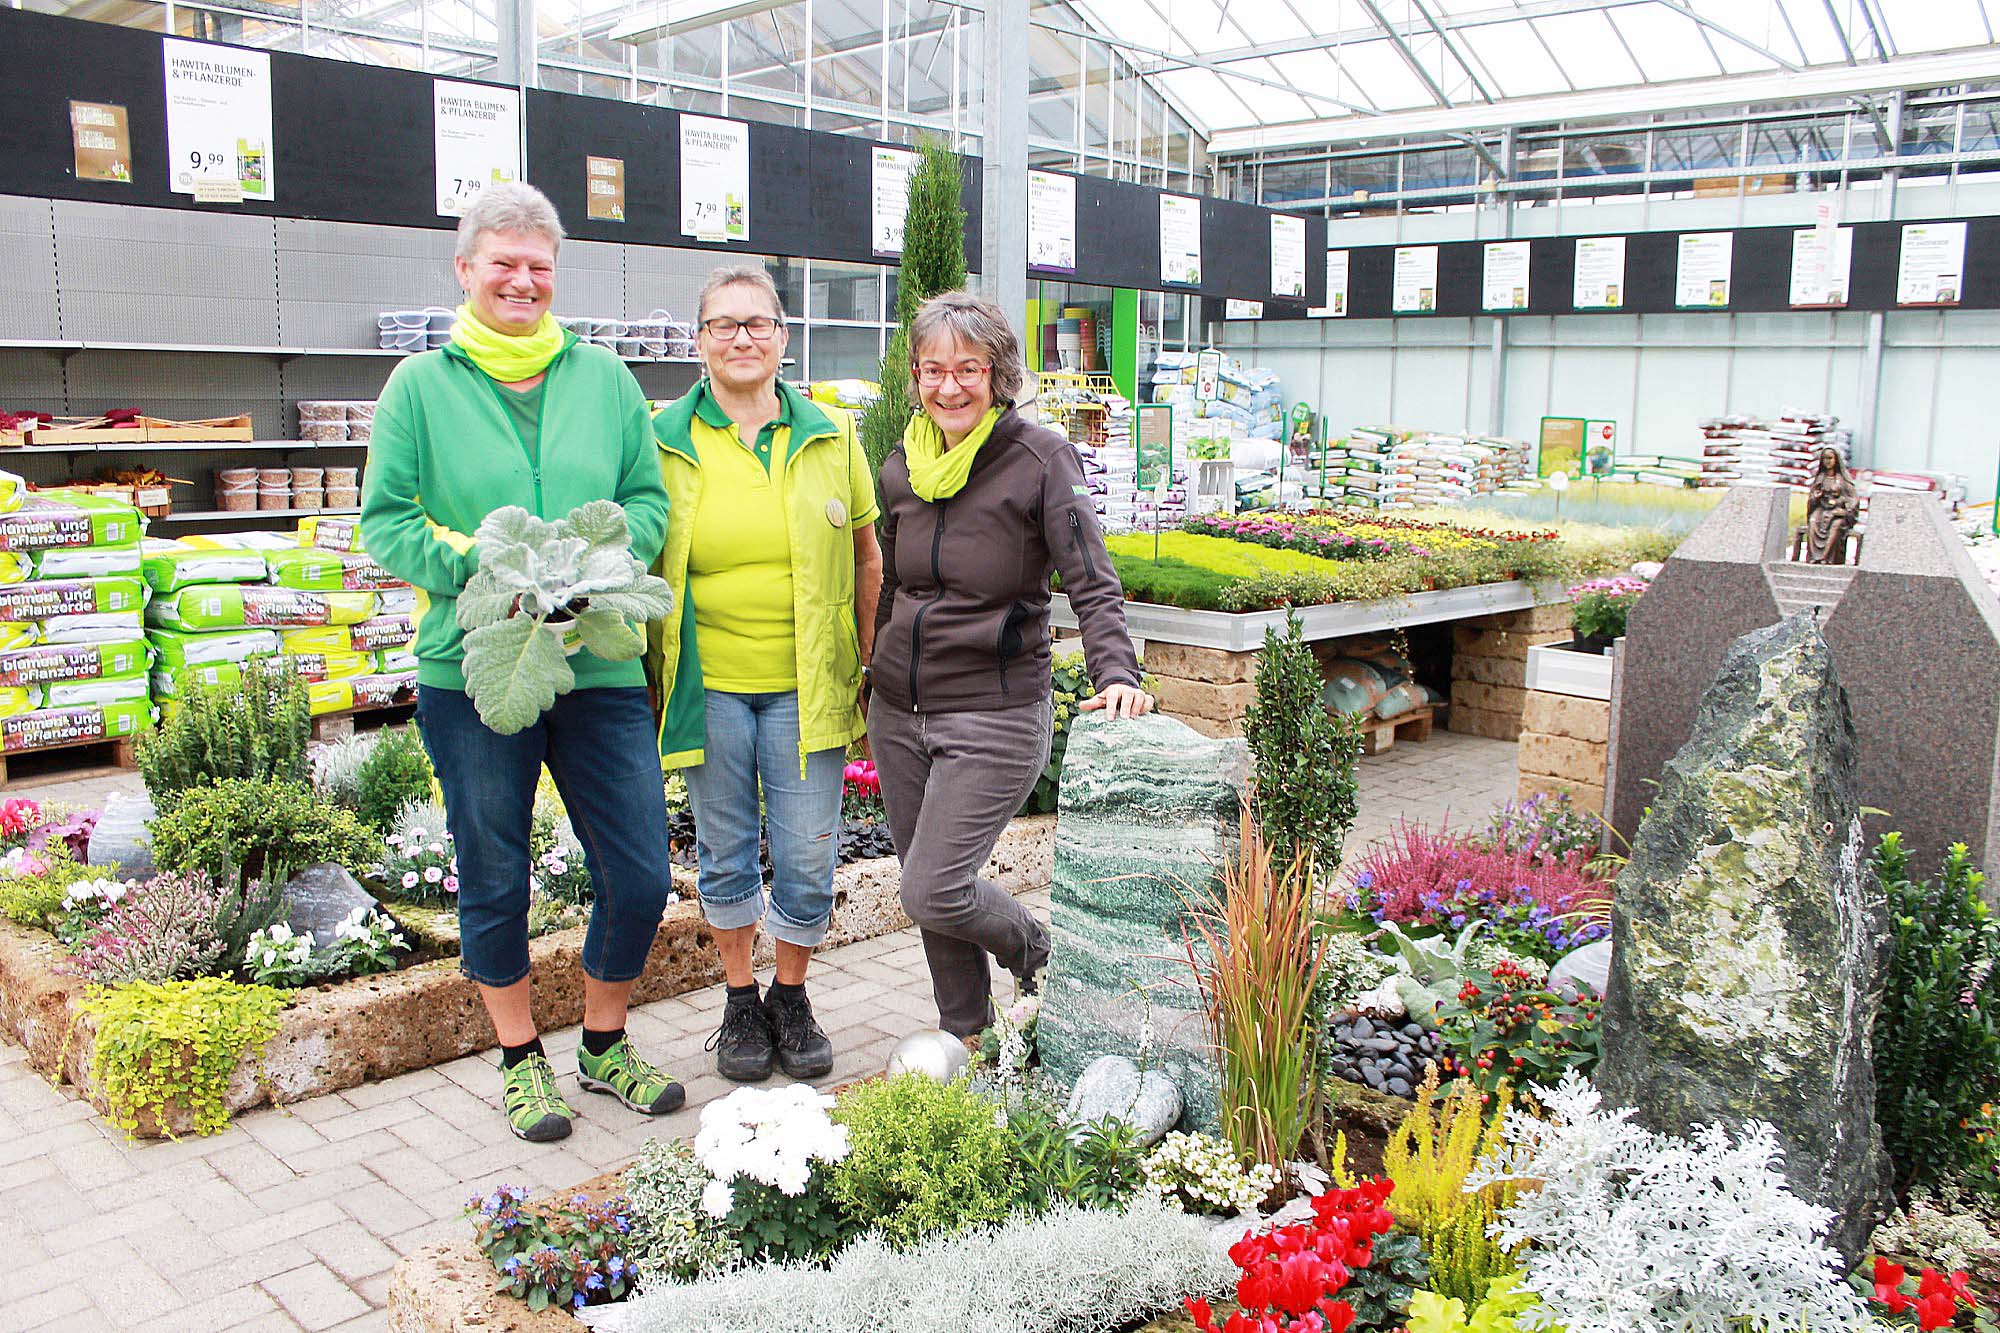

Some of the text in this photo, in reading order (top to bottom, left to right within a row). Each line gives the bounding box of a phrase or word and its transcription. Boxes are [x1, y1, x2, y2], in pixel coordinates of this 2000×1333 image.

[172, 58, 257, 78] HAWITA BLUMEN-
[172, 69, 244, 87] & PFLANZERDE
[440, 97, 472, 109] HAWITA
[440, 107, 497, 121] & PFLANZERDE
[190, 151, 224, 173] 9,99
[454, 178, 481, 198] 7,99
[60, 519, 89, 532] und
[9, 531, 89, 548] pflanzerde
[64, 589, 93, 601] und
[13, 601, 93, 619] pflanzerde
[257, 603, 325, 618] pflanzerde
[365, 631, 416, 647] pflanzer
[69, 652, 97, 665] und
[20, 664, 98, 684] pflanzerde
[73, 712, 101, 725] und
[23, 725, 102, 744] pflanzerde
